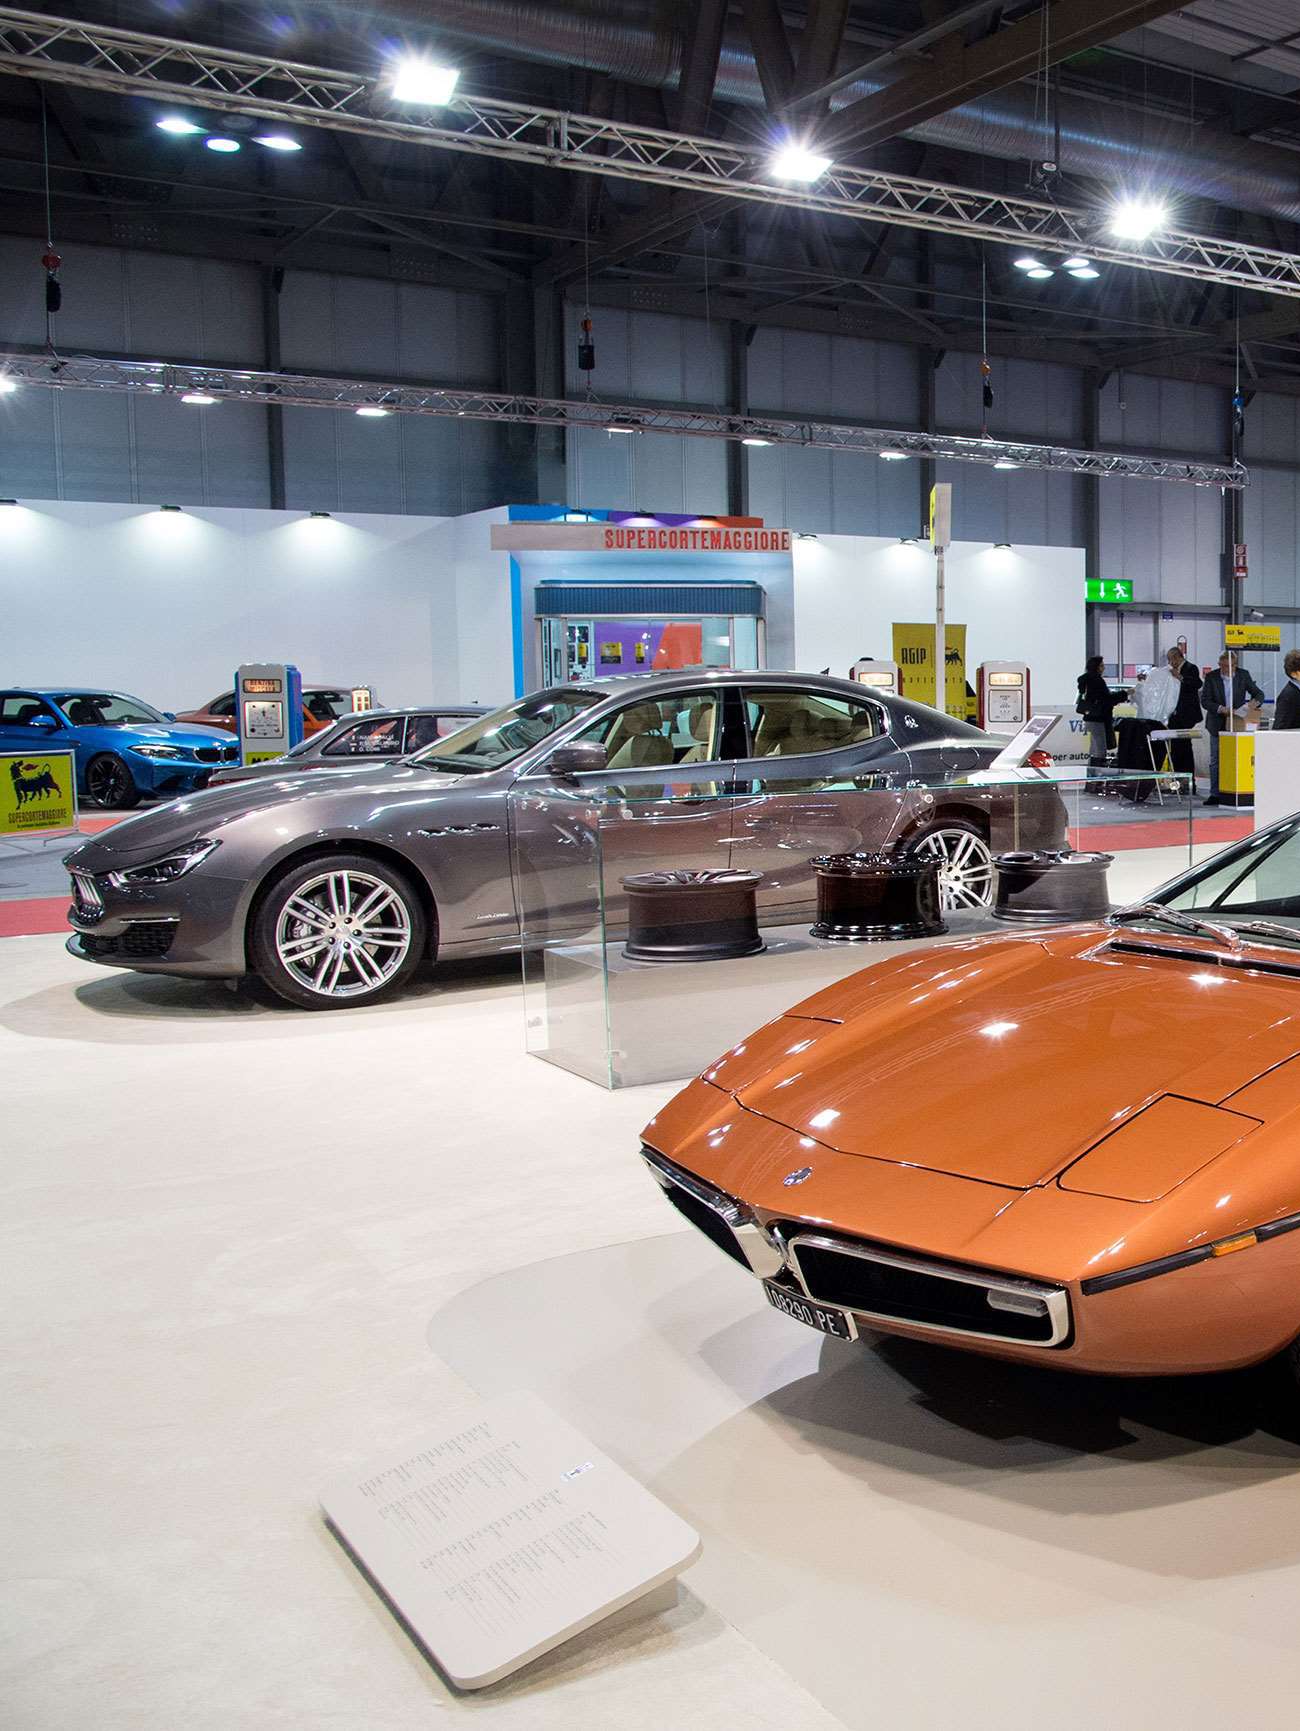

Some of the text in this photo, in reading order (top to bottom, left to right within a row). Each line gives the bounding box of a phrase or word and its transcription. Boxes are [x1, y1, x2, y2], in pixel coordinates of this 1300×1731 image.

[604, 529, 790, 551] SUPERCORTEMAGGIORE
[901, 647, 927, 665] AGIP
[815, 1309, 840, 1336] PE
